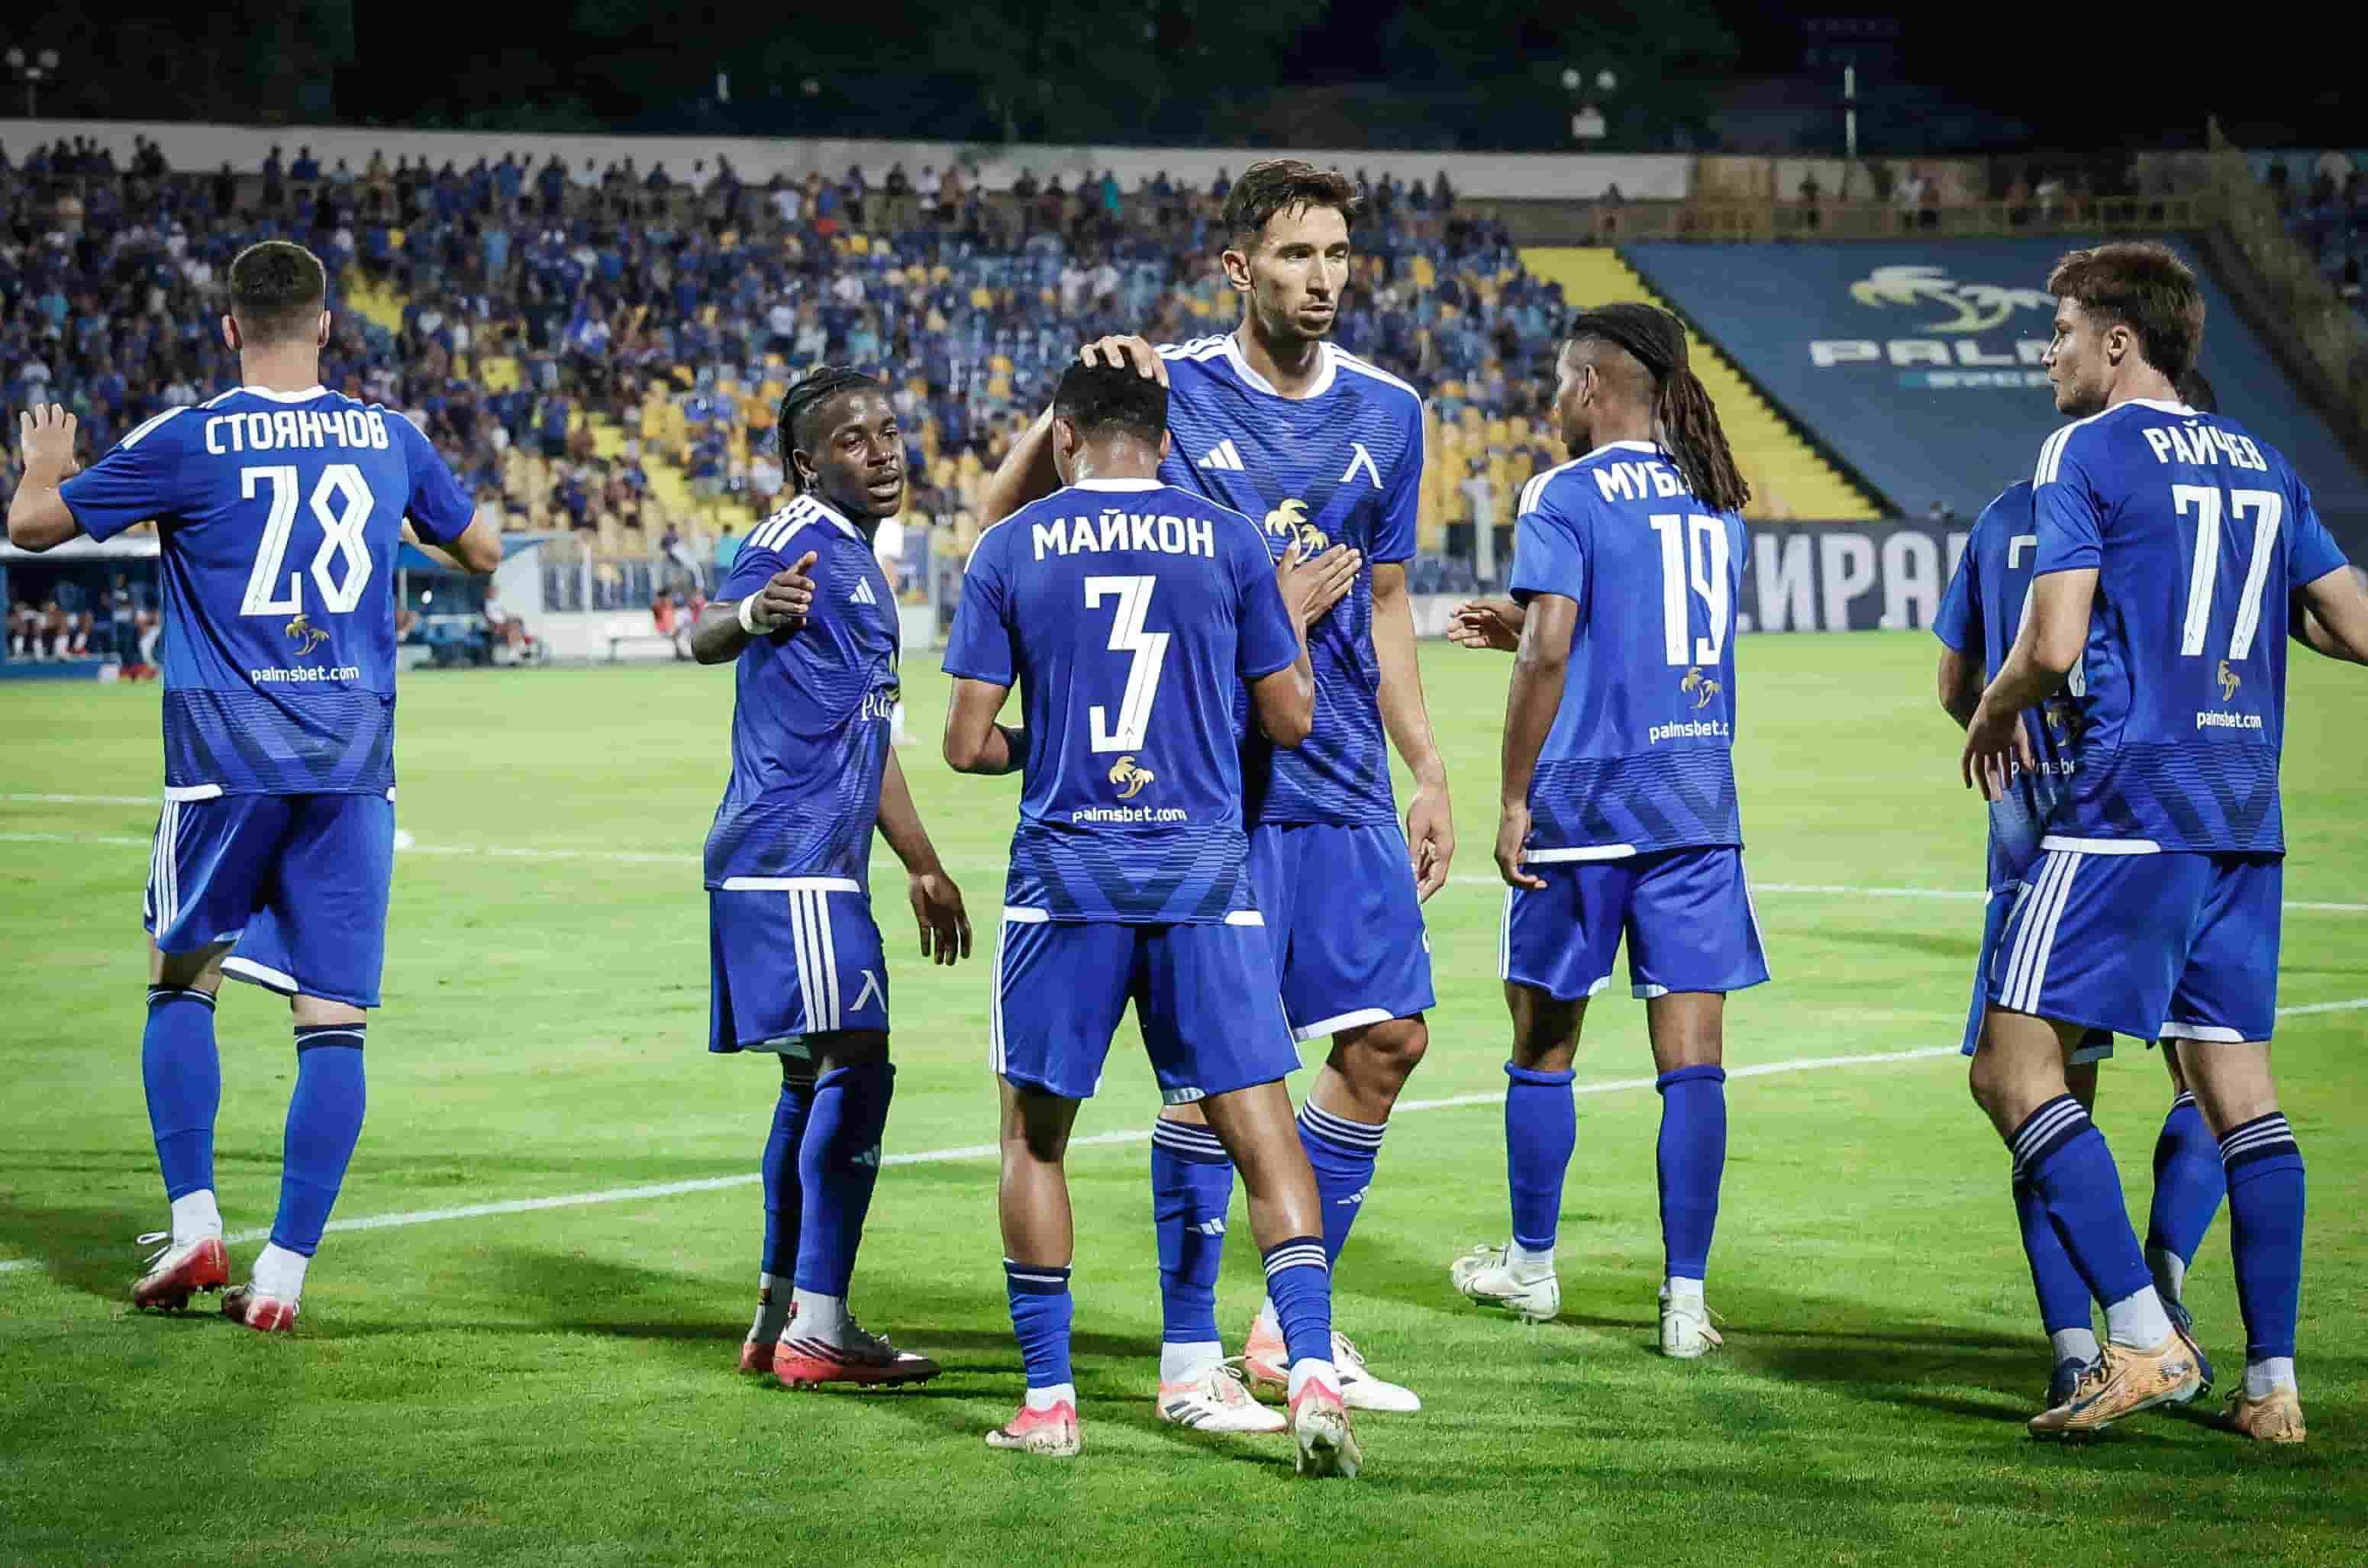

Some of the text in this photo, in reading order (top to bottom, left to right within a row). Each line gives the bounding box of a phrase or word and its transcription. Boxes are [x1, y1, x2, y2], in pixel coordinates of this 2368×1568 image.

[205, 408, 390, 456] СТОЯНЧОВ
[2142, 420, 2268, 472] РАЙЧЕВ
[239, 463, 376, 617] 28
[1031, 508, 1216, 562] МАЙКОН
[1649, 513, 1731, 666] 19
[2171, 483, 2283, 661] 77
[250, 664, 360, 686] palmsbet.com
[1083, 574, 1171, 754] 3
[1072, 805, 1188, 824] palmsbet.com
